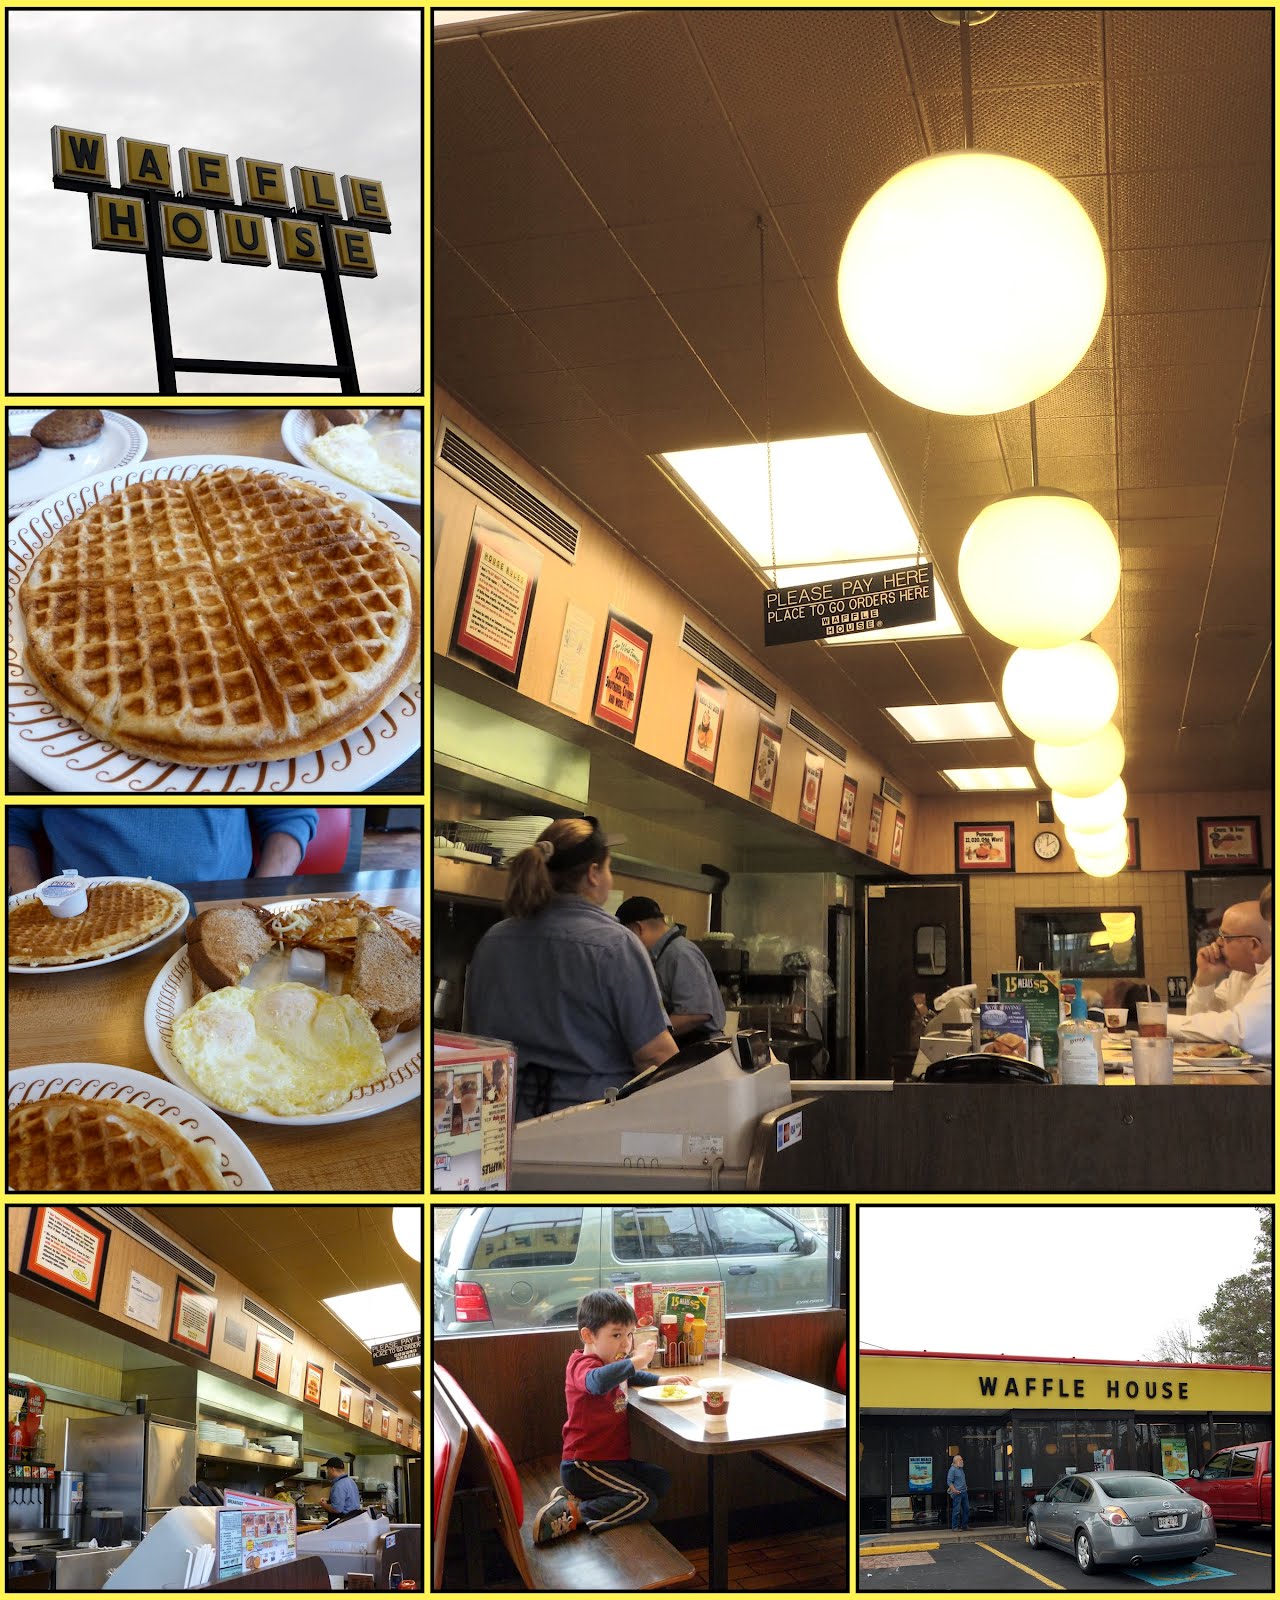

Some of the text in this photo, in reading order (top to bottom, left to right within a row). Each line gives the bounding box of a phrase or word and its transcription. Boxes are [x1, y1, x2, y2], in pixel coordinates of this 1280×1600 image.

[67, 135, 383, 213] WAFFLE
[108, 202, 369, 264] HOUSE
[484, 552, 504, 571] HOUSE
[766, 567, 929, 608] PLEASE PAY HERE
[767, 585, 930, 623] PLACE TO GO ORDERS HERE
[822, 609, 879, 626] WAFFLE
[1005, 976, 1049, 994] 15 MEALS $5
[481, 1160, 503, 1176] WAFFLES
[671, 1296, 680, 1307] 15
[372, 1340, 398, 1353] PLEASE
[400, 1336, 414, 1345] PAY
[978, 1376, 1189, 1400] WAFFLE HOUSE
